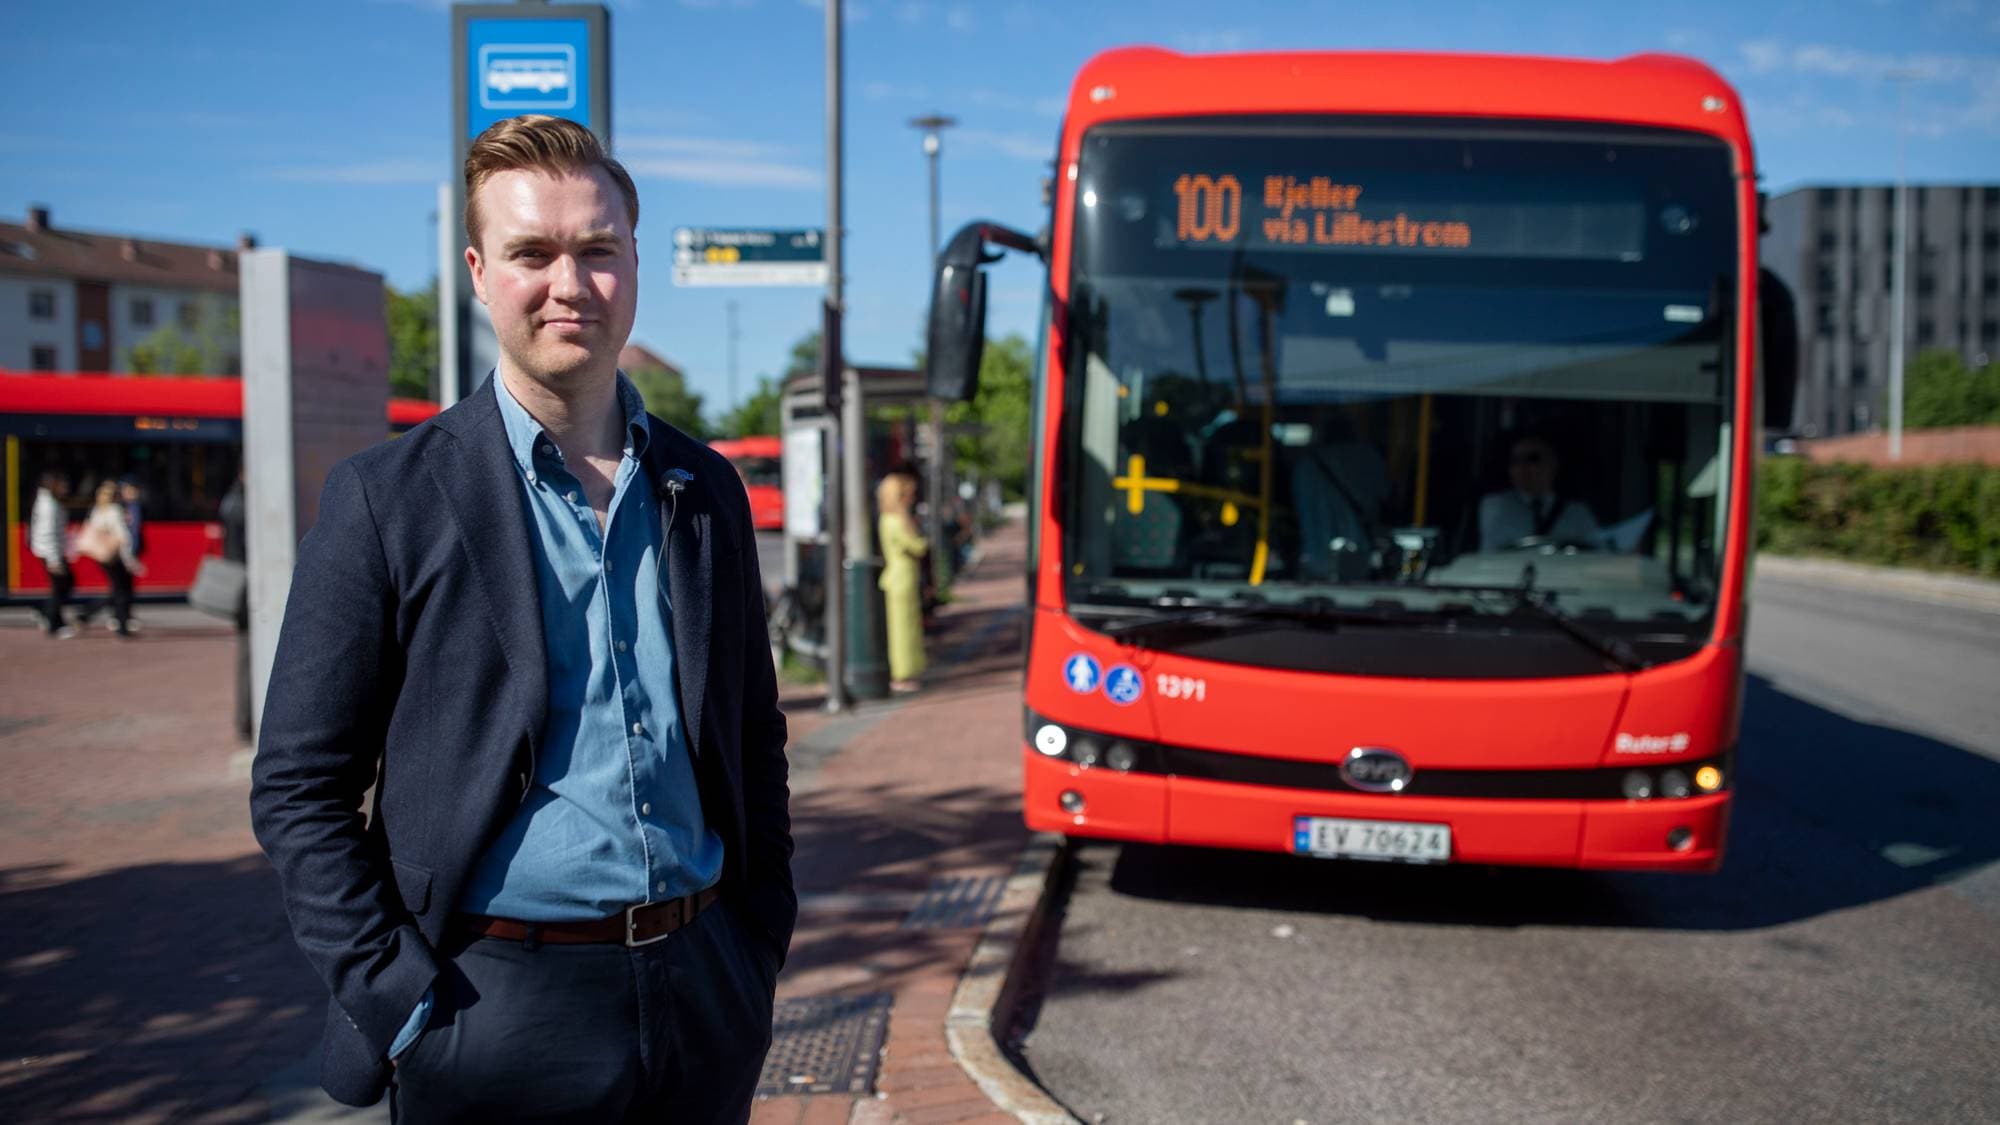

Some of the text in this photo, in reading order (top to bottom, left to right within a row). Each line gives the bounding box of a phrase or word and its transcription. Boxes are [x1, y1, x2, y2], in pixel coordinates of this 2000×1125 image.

[1174, 174, 1241, 242] 100
[1263, 175, 1362, 218] Kjeller
[1263, 218, 1308, 244] via
[1157, 673, 1206, 702] 1391
[1316, 825, 1442, 854] EV 70624
